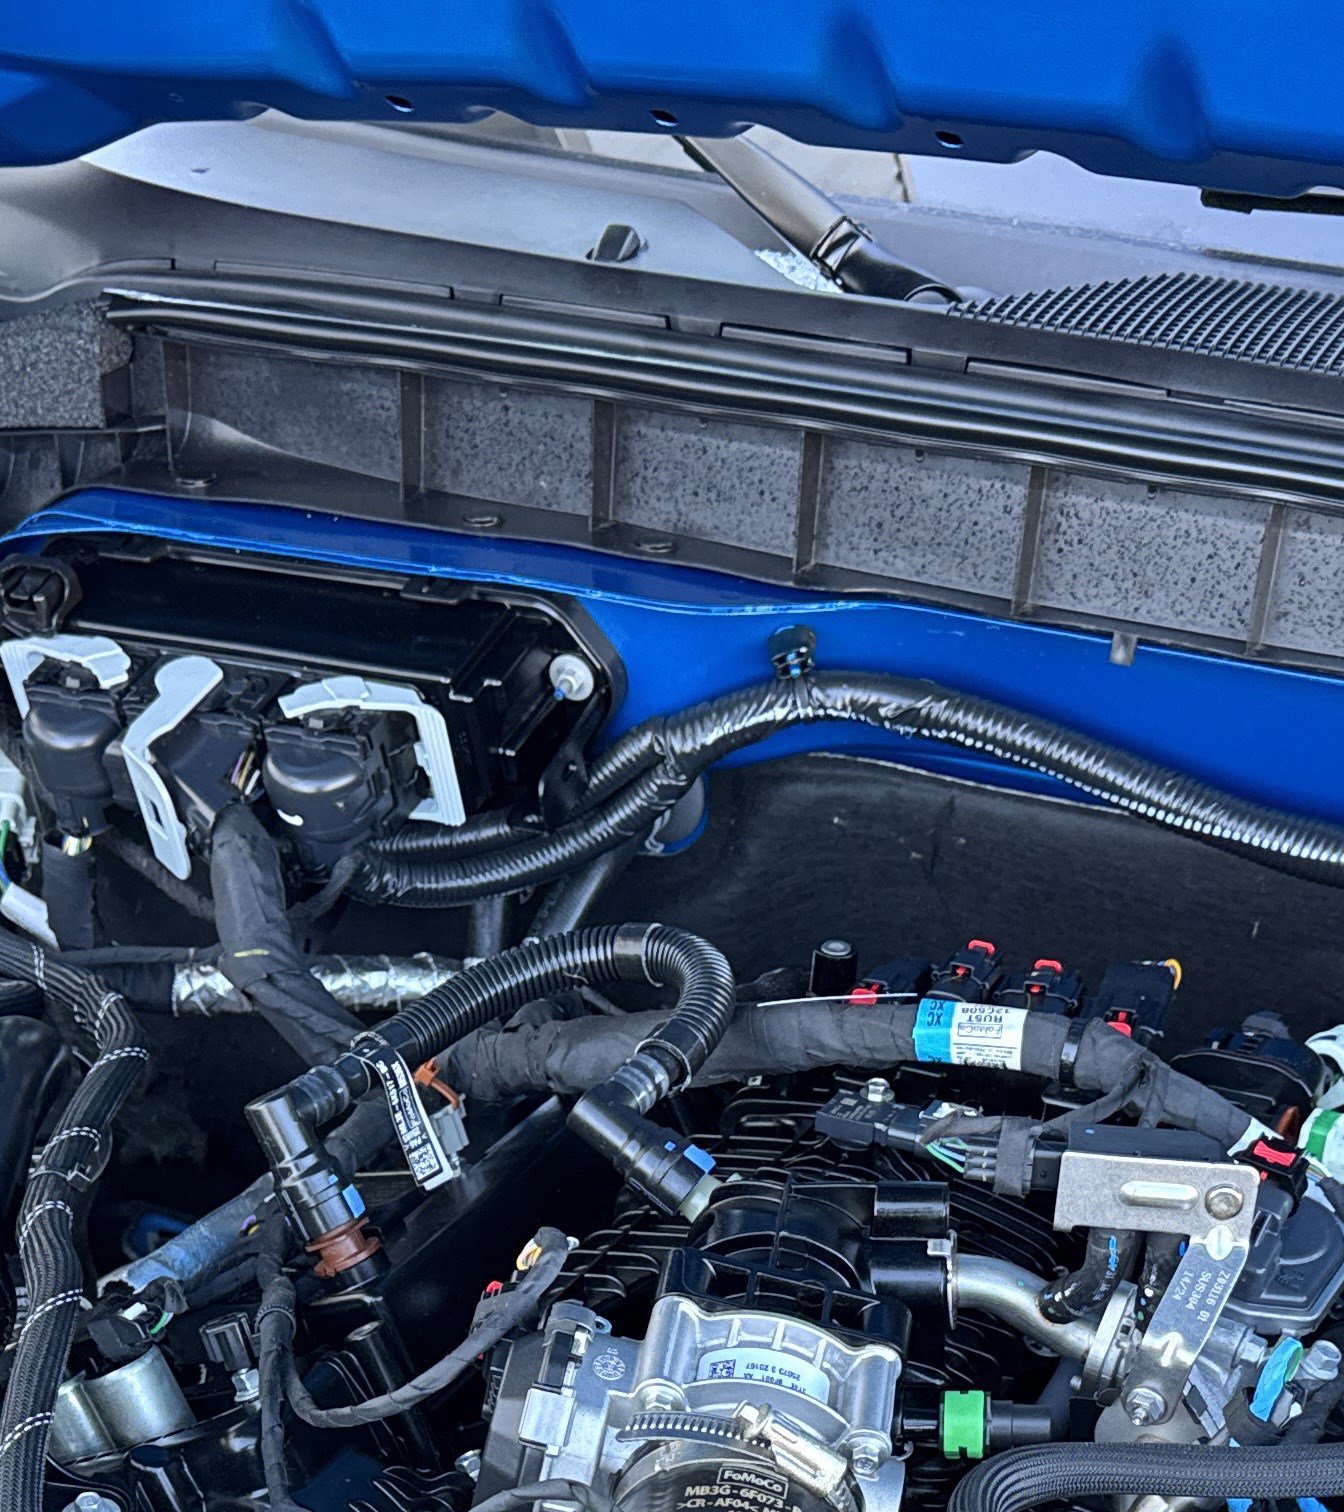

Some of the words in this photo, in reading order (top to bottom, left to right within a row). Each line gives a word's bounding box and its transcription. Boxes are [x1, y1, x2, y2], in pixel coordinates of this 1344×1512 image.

[927, 1012, 942, 1026] XC
[959, 1025, 1000, 1035] FoMoCo
[723, 1470, 783, 1493] FoMoCo
